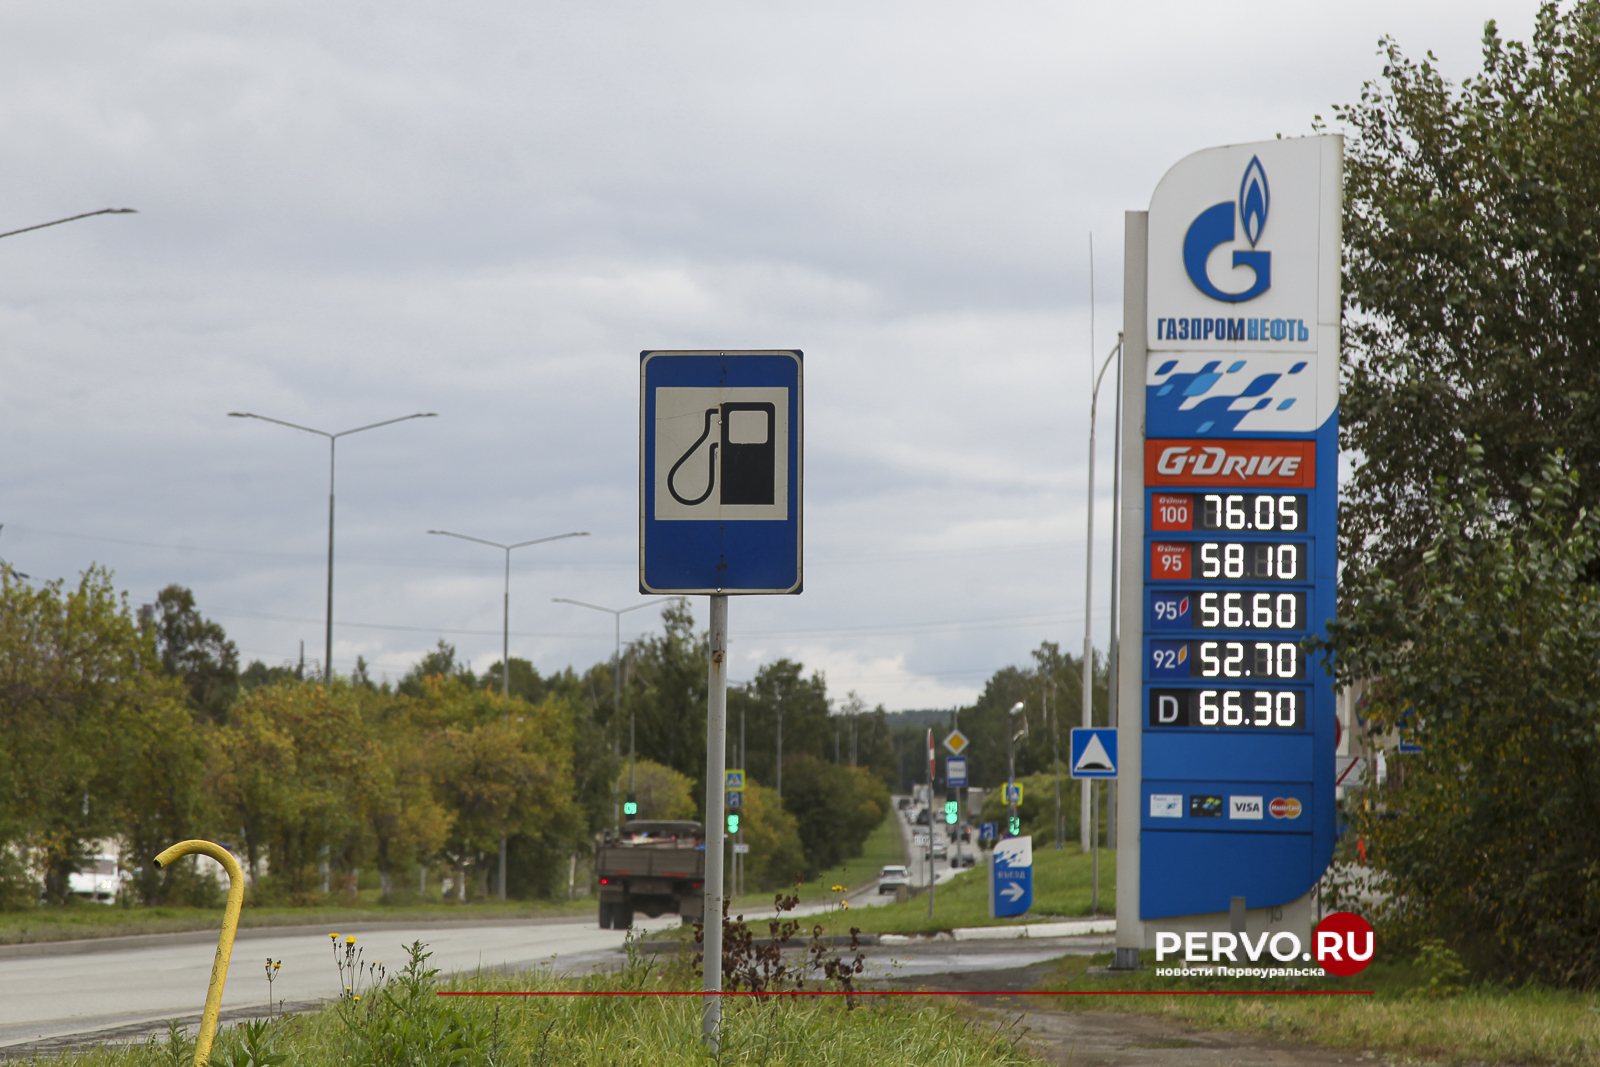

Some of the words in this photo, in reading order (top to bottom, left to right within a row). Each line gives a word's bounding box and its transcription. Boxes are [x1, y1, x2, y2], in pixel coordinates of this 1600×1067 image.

[1157, 318, 1309, 341] ГАЗПРОМНЕФТЬ
[1160, 506, 1188, 523] 100
[1204, 495, 1298, 530] 76.05
[1162, 555, 1182, 571] 95
[1154, 602, 1177, 620] 95
[1200, 592, 1296, 628] 56.60
[1153, 650, 1176, 669] 92
[1200, 642, 1296, 678] 52.70
[1158, 696, 1178, 722] D
[1199, 691, 1296, 726] 66.30
[1235, 802, 1260, 812] VISA
